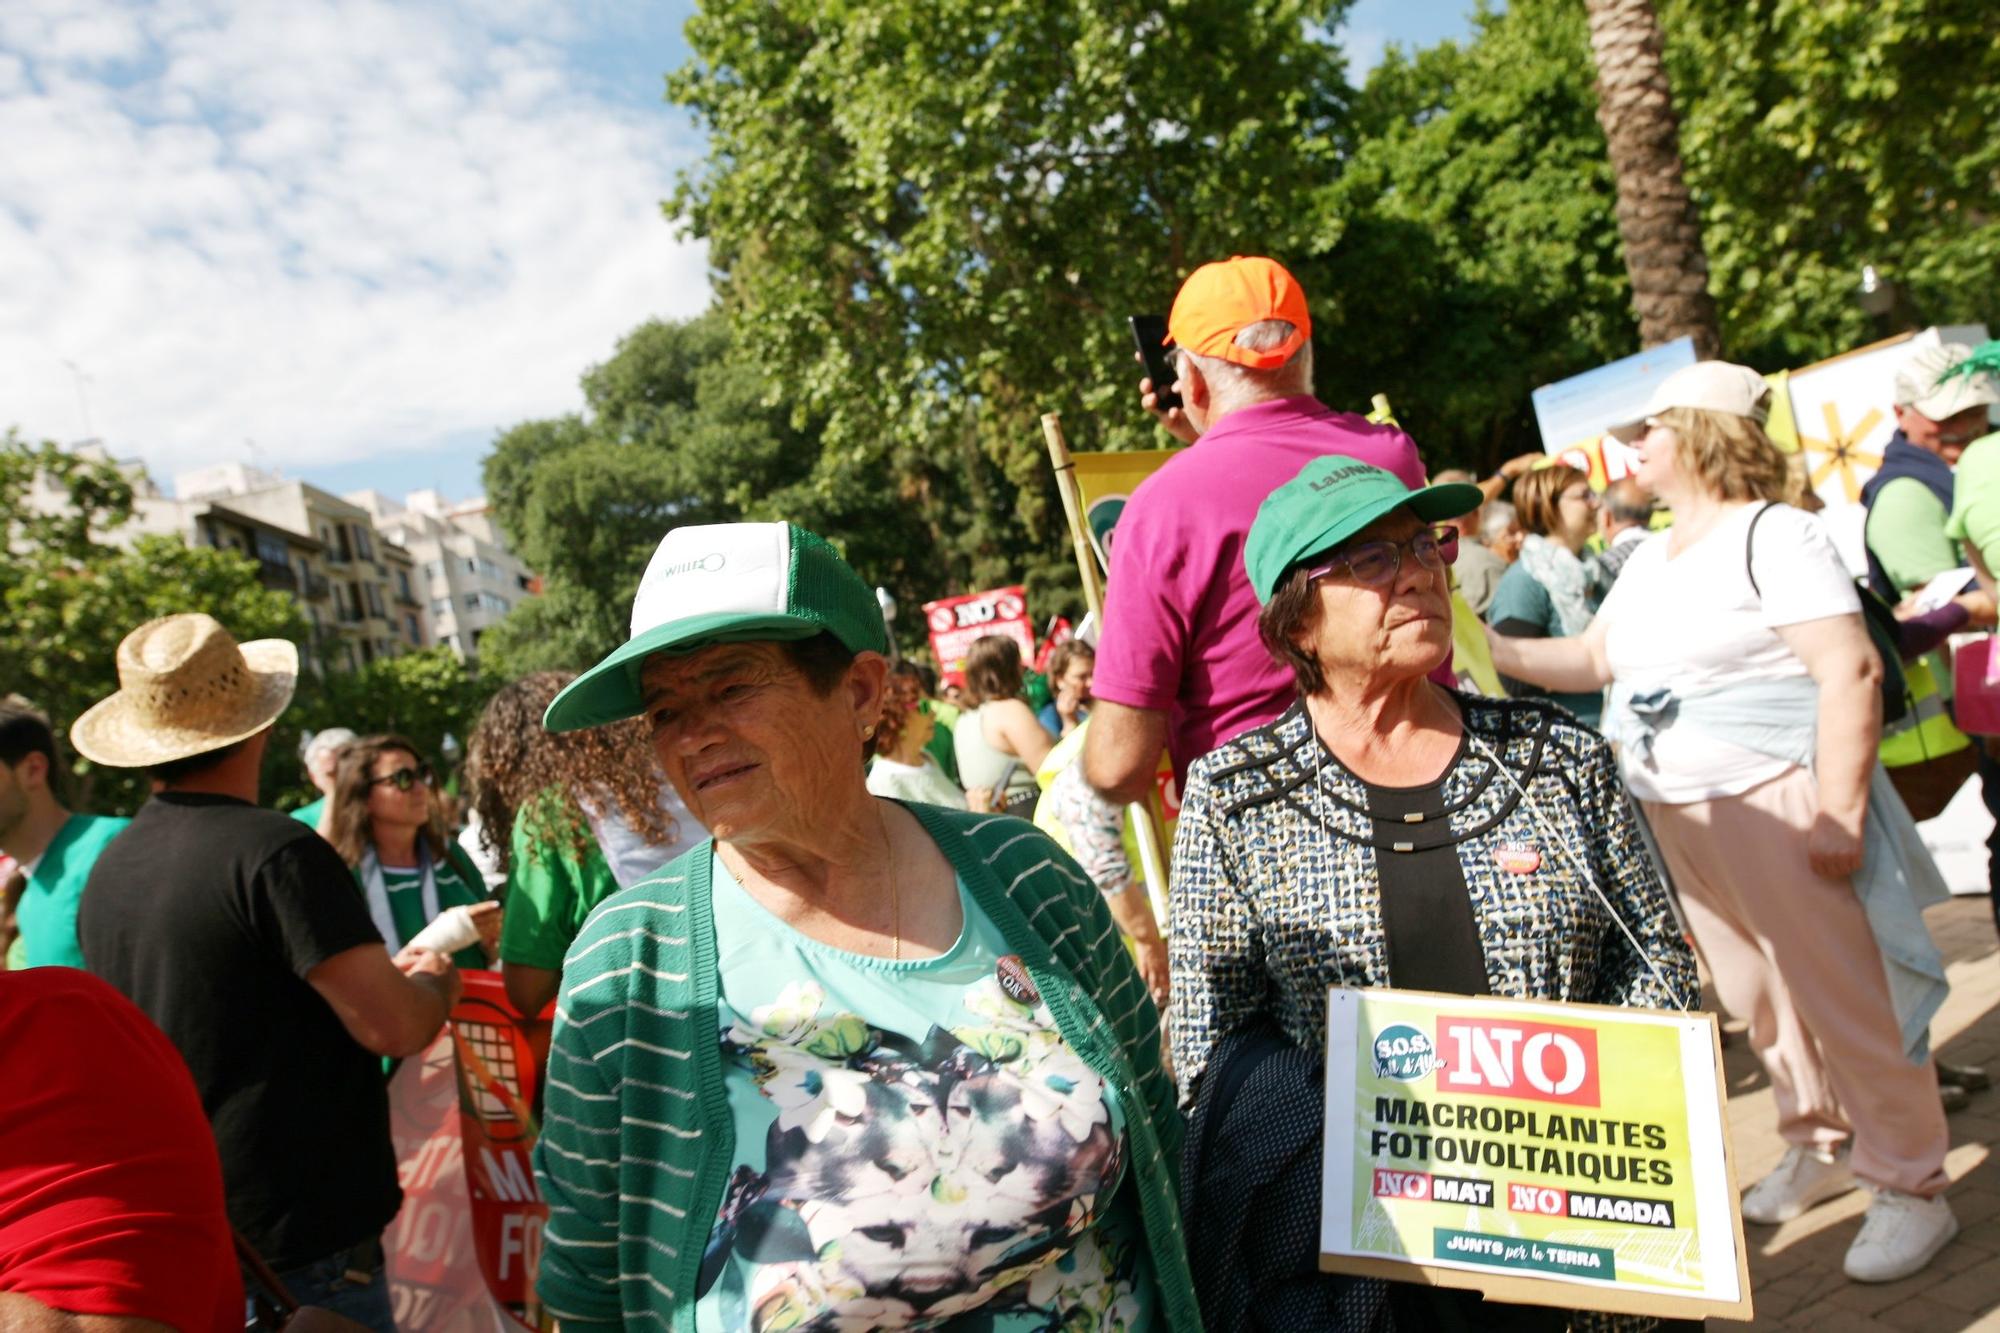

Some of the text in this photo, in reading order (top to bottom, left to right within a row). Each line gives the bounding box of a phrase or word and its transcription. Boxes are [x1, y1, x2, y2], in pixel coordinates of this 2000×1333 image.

[954, 601, 996, 628] NO
[1449, 1024, 1586, 1095] NO
[1375, 1097, 1667, 1150] MACROPLANTES
[1371, 1130, 1674, 1186] FOTOVOLTAIQUES
[1377, 1171, 1672, 1226] NO MAT NO MAGDA
[1447, 1235, 1601, 1268] JUNTS per la TERRA
